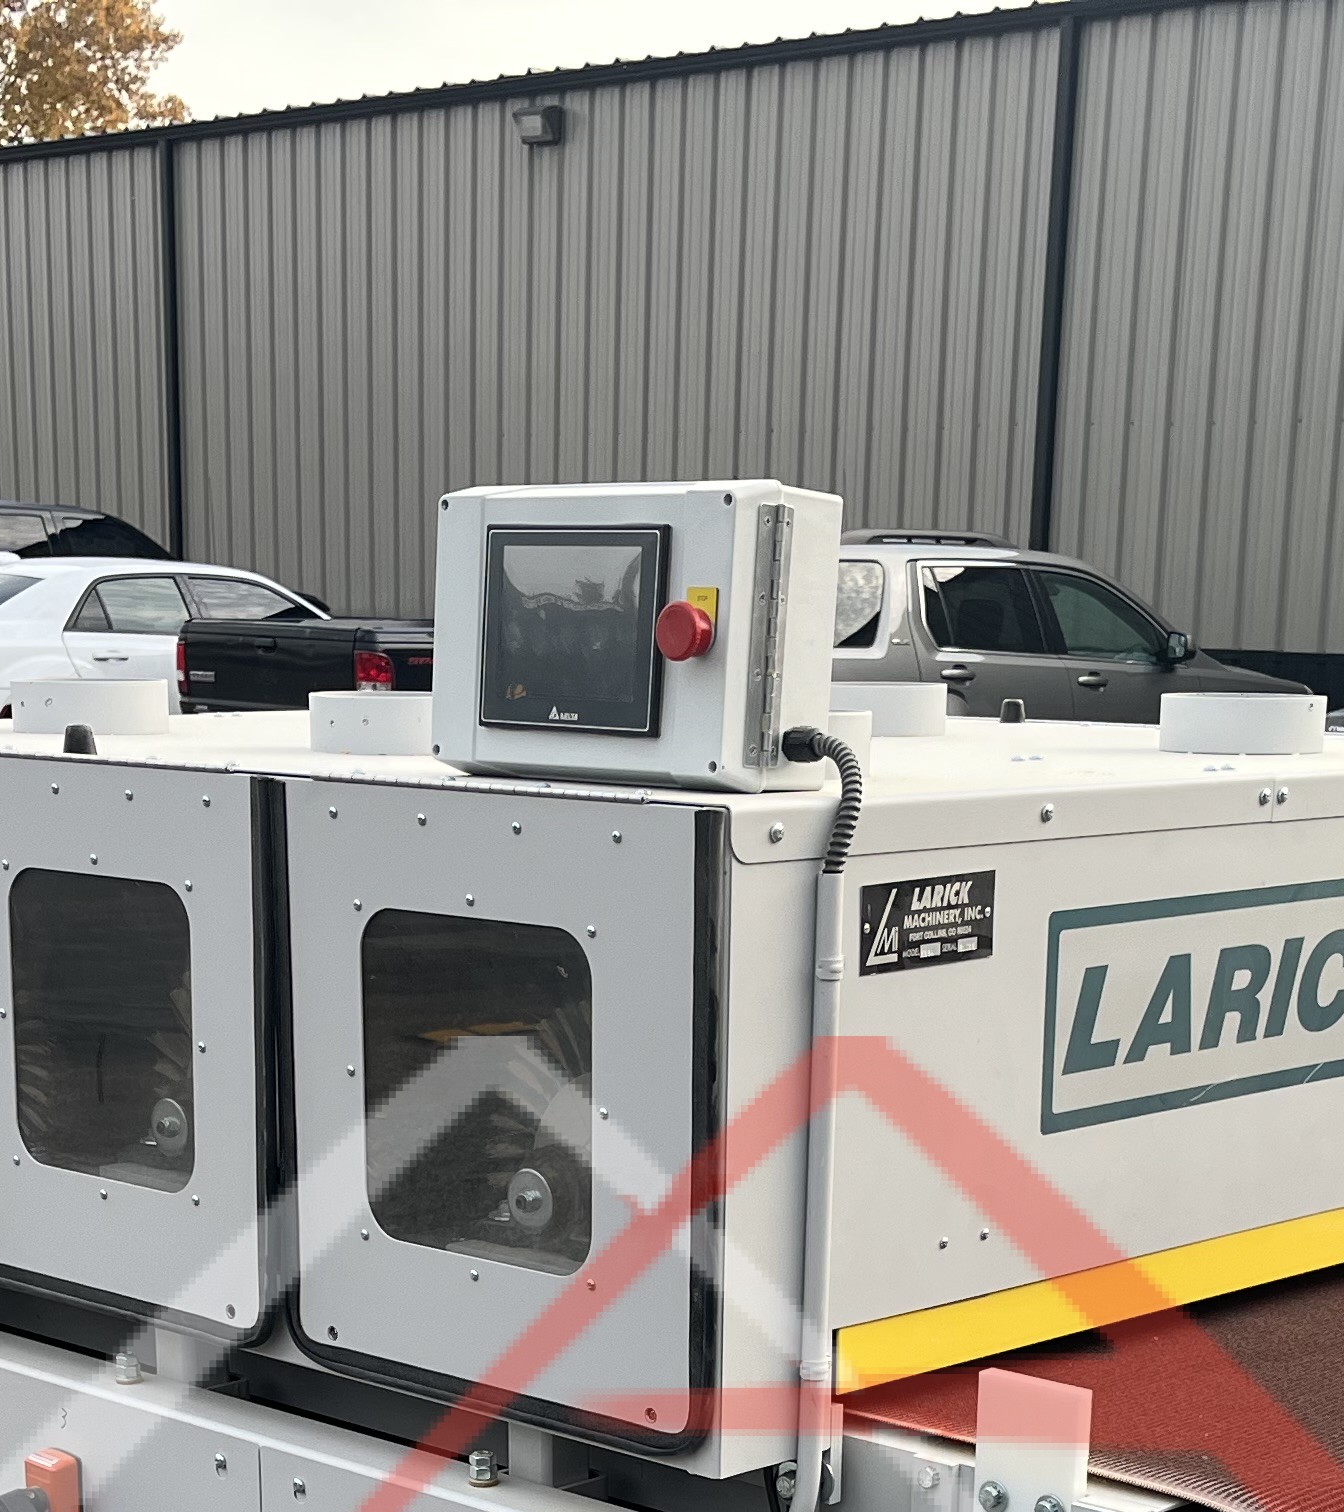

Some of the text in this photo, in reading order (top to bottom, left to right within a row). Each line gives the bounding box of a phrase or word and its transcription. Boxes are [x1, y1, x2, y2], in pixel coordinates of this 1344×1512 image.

[911, 880, 973, 911] LARICK
[903, 908, 962, 930] MACHINERY,
[964, 905, 984, 921] INC.
[61, 1407, 68, 1429] 3
